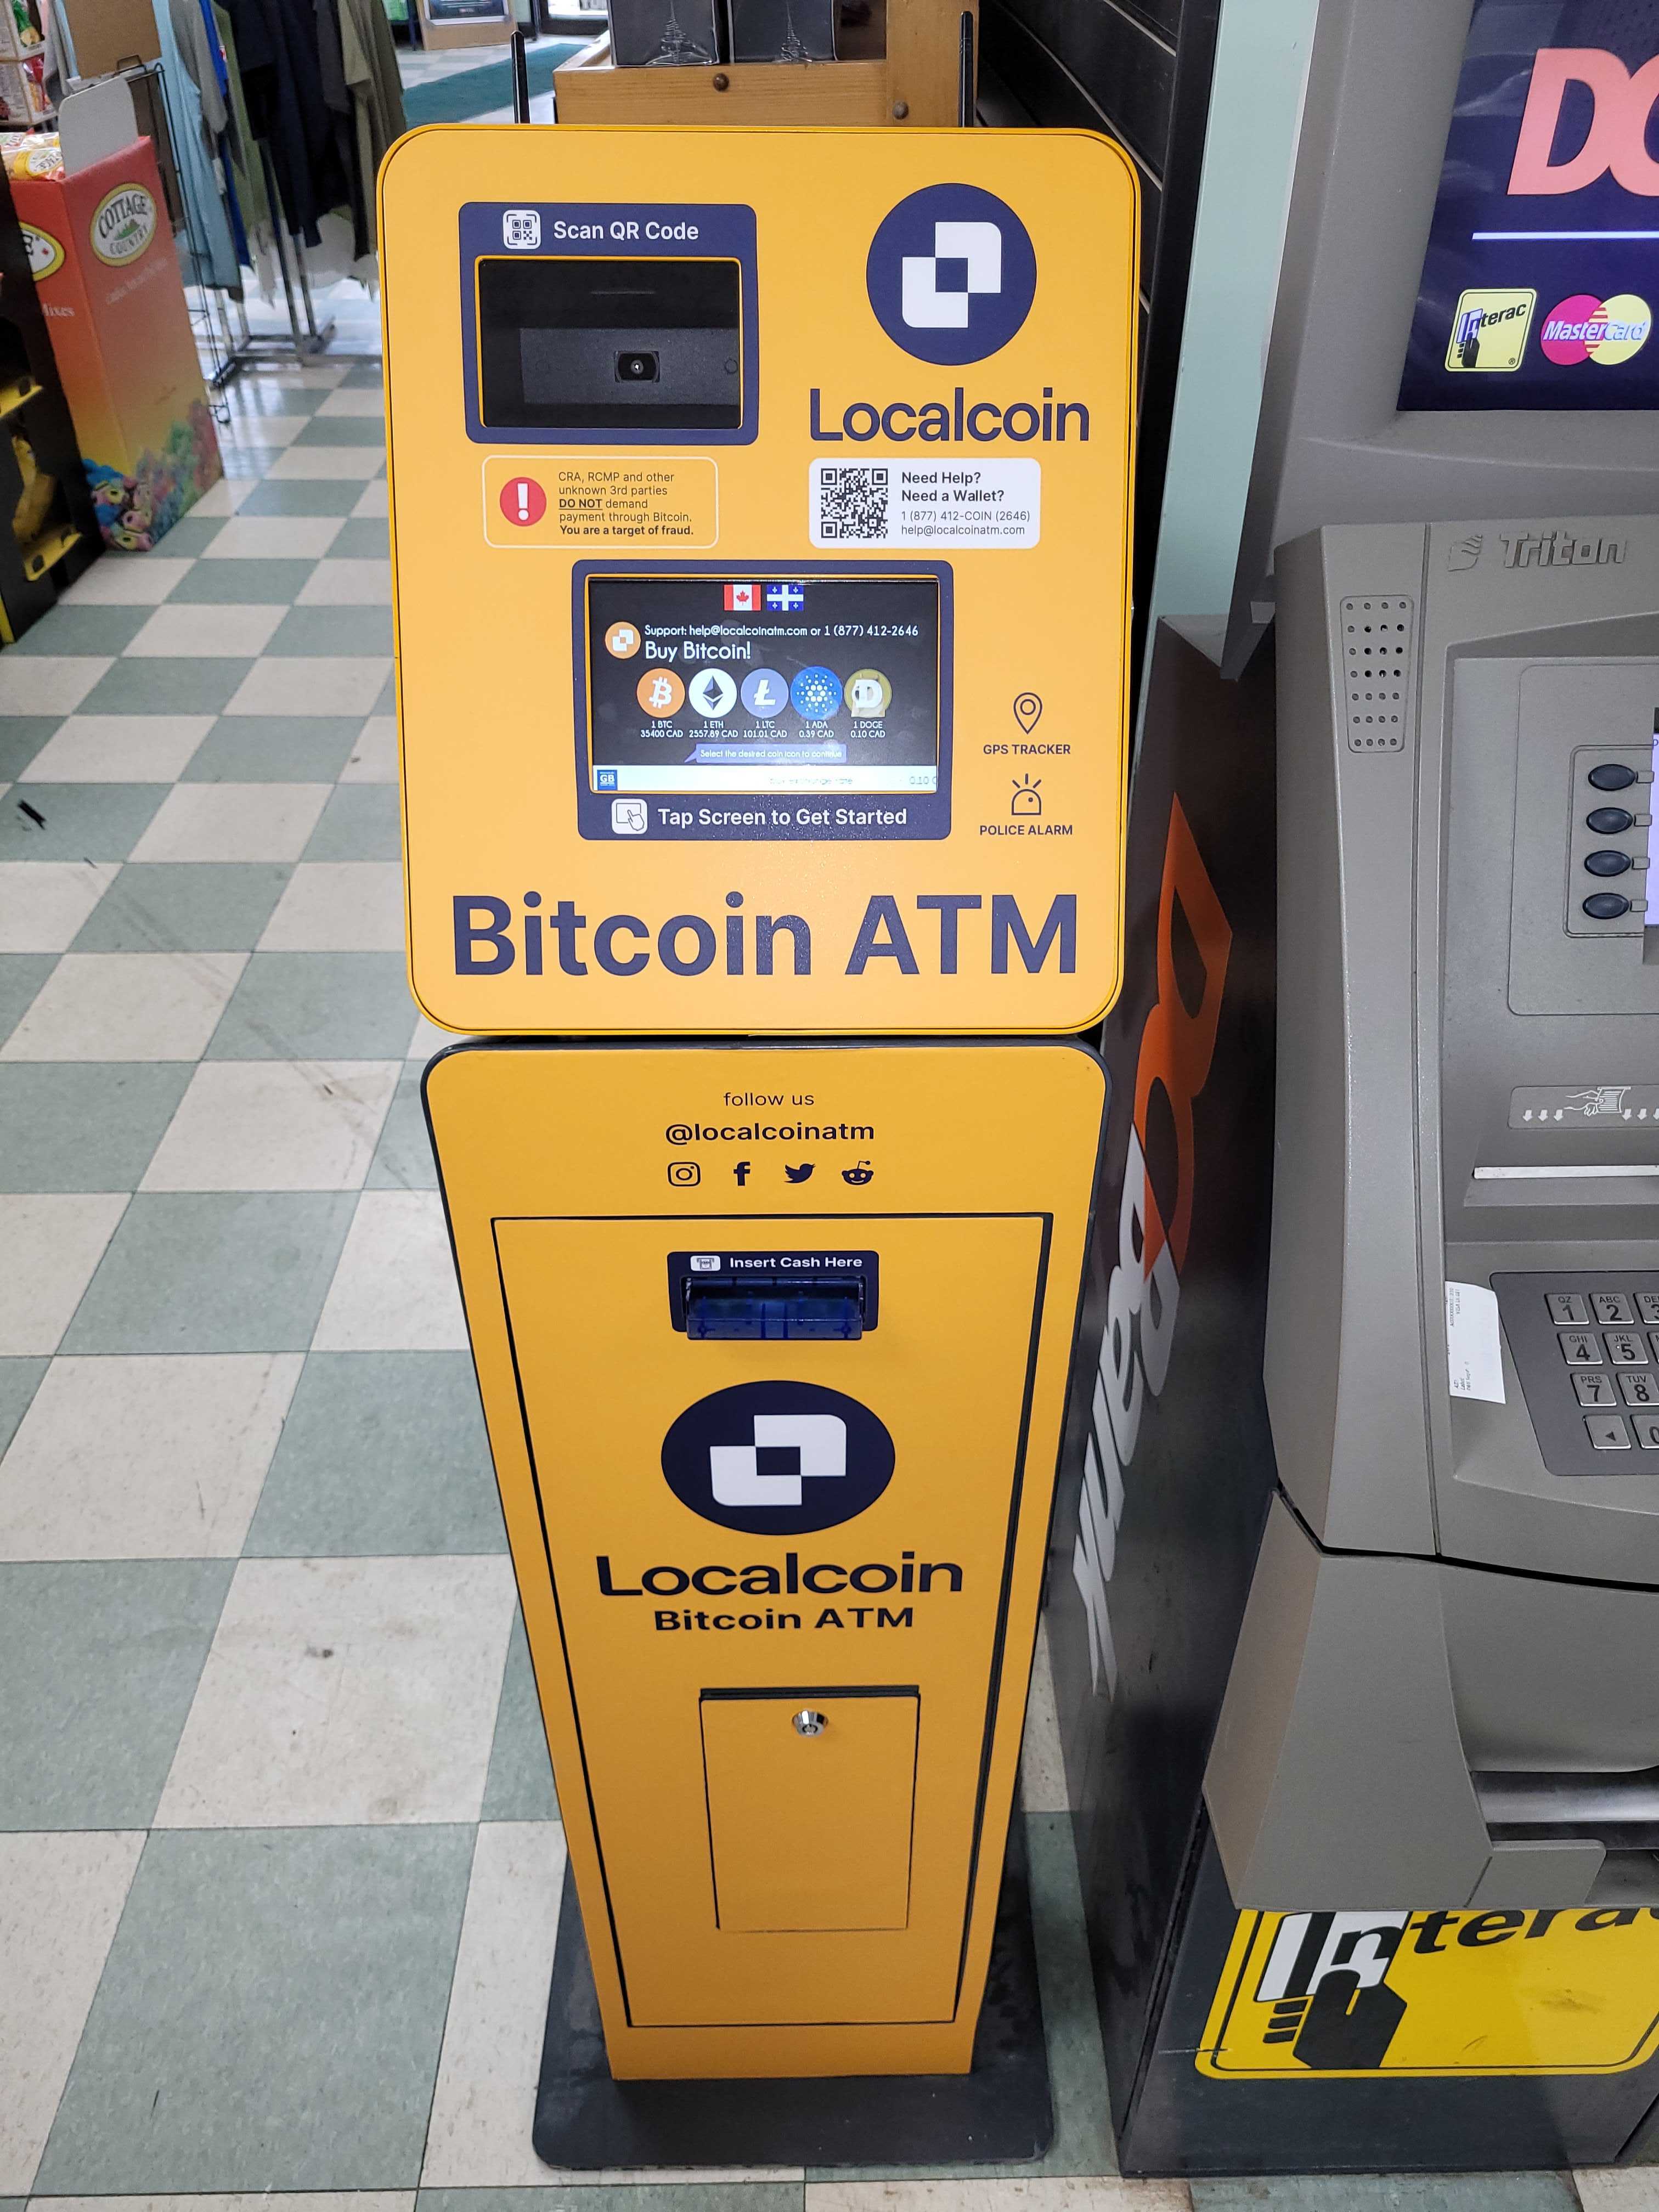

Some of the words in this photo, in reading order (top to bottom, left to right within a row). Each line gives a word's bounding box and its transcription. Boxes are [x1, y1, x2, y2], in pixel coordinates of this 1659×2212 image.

[98, 194, 148, 239] COTTAGE
[554, 221, 603, 239] Scan
[610, 221, 640, 241] QR
[645, 221, 699, 240] Code
[1458, 303, 1527, 342] Interac
[1542, 319, 1647, 341] MasterCard
[810, 387, 1090, 442] Localcoin
[558, 471, 584, 483] CRA,
[588, 471, 620, 482] RCMP
[623, 472, 642, 482] and
[646, 472, 675, 482] other
[902, 472, 938, 483] Need
[942, 472, 981, 487] Help?
[558, 485, 606, 495] unknown
[610, 485, 628, 495] 3rd
[631, 485, 668, 498] parties
[902, 489, 937, 501] Need
[941, 493, 949, 501] a
[953, 489, 1005, 501] Wallet?
[559, 498, 575, 509] DO
[579, 499, 603, 509] NOT
[605, 499, 648, 509] demand
[560, 512, 605, 524] payment
[609, 512, 650, 524] through
[653, 512, 692, 522] Bitcoin.
[901, 511, 905, 521] 1
[910, 511, 936, 522] (877)
[940, 511, 992, 521] 412-COIN
[996, 510, 1030, 522] (2646)
[560, 525, 580, 534] You
[612, 526, 645, 537] target
[648, 525, 659, 535] of
[662, 525, 693, 535] fraud.
[901, 524, 1025, 537] help@localcoinatm.com
[1499, 531, 1627, 568] Triton
[645, 624, 687, 637] Support:
[689, 624, 808, 637] help@localcoinatm.com
[810, 628, 821, 636] or
[824, 625, 831, 636] 1
[833, 624, 864, 637] (877)
[867, 624, 918, 636] 412-2646
[645, 640, 678, 663] Buy
[684, 641, 751, 660] Bitcoin!
[651, 720, 656, 729] 1
[657, 720, 673, 729] BTC
[703, 720, 708, 729] 1
[709, 720, 724, 729] ETH
[755, 720, 760, 729] 1
[761, 720, 776, 729] LTC
[805, 720, 810, 729] 1
[811, 720, 828, 729] ADA
[853, 720, 858, 729] 1
[860, 720, 883, 729] DOGE
[640, 729, 665, 738] 35400
[665, 729, 684, 738] CAD
[689, 730, 720, 738] 2557.89
[721, 729, 738, 738] CAD
[743, 730, 769, 738] 101.01
[770, 730, 788, 738] CAD
[799, 730, 815, 738] 0.39
[817, 730, 834, 738] CAD
[850, 730, 867, 738] 0.10
[868, 730, 885, 738] CAD
[701, 749, 723, 758] Select
[725, 749, 737, 758] the
[738, 749, 766, 758] desired
[768, 749, 783, 758] coin
[785, 749, 799, 758] icon
[802, 749, 809, 758] to
[811, 749, 842, 758] continue
[983, 744, 1009, 755] GPS
[1011, 744, 1071, 755] TRACKER
[600, 774, 615, 782] GB
[658, 809, 693, 830] Tap
[699, 809, 766, 826] Screen
[771, 810, 790, 826] to
[795, 809, 831, 826] Get
[835, 809, 907, 826] Started
[980, 825, 1025, 836] POLICE
[1028, 825, 1073, 836] ALARM
[453, 891, 811, 977] Bitcoin
[844, 894, 1077, 975] ATM
[723, 1092, 784, 1107] follow
[792, 1094, 814, 1105] us
[665, 1121, 874, 1146] @localcoinatm
[730, 1257, 776, 1268] Insert
[780, 1257, 820, 1267] Cash
[825, 1257, 862, 1267] Here
[1562, 1304, 1575, 1321] 1
[1606, 1304, 1622, 1321] 2
[1576, 1344, 1590, 1361] 4
[1621, 1344, 1635, 1361] 5
[1587, 1385, 1600, 1402] 7
[1634, 1384, 1650, 1402] 8
[596, 1551, 963, 1596] Localcoin
[654, 1608, 801, 1630] Bitcoin
[815, 1607, 913, 1629] ATM
